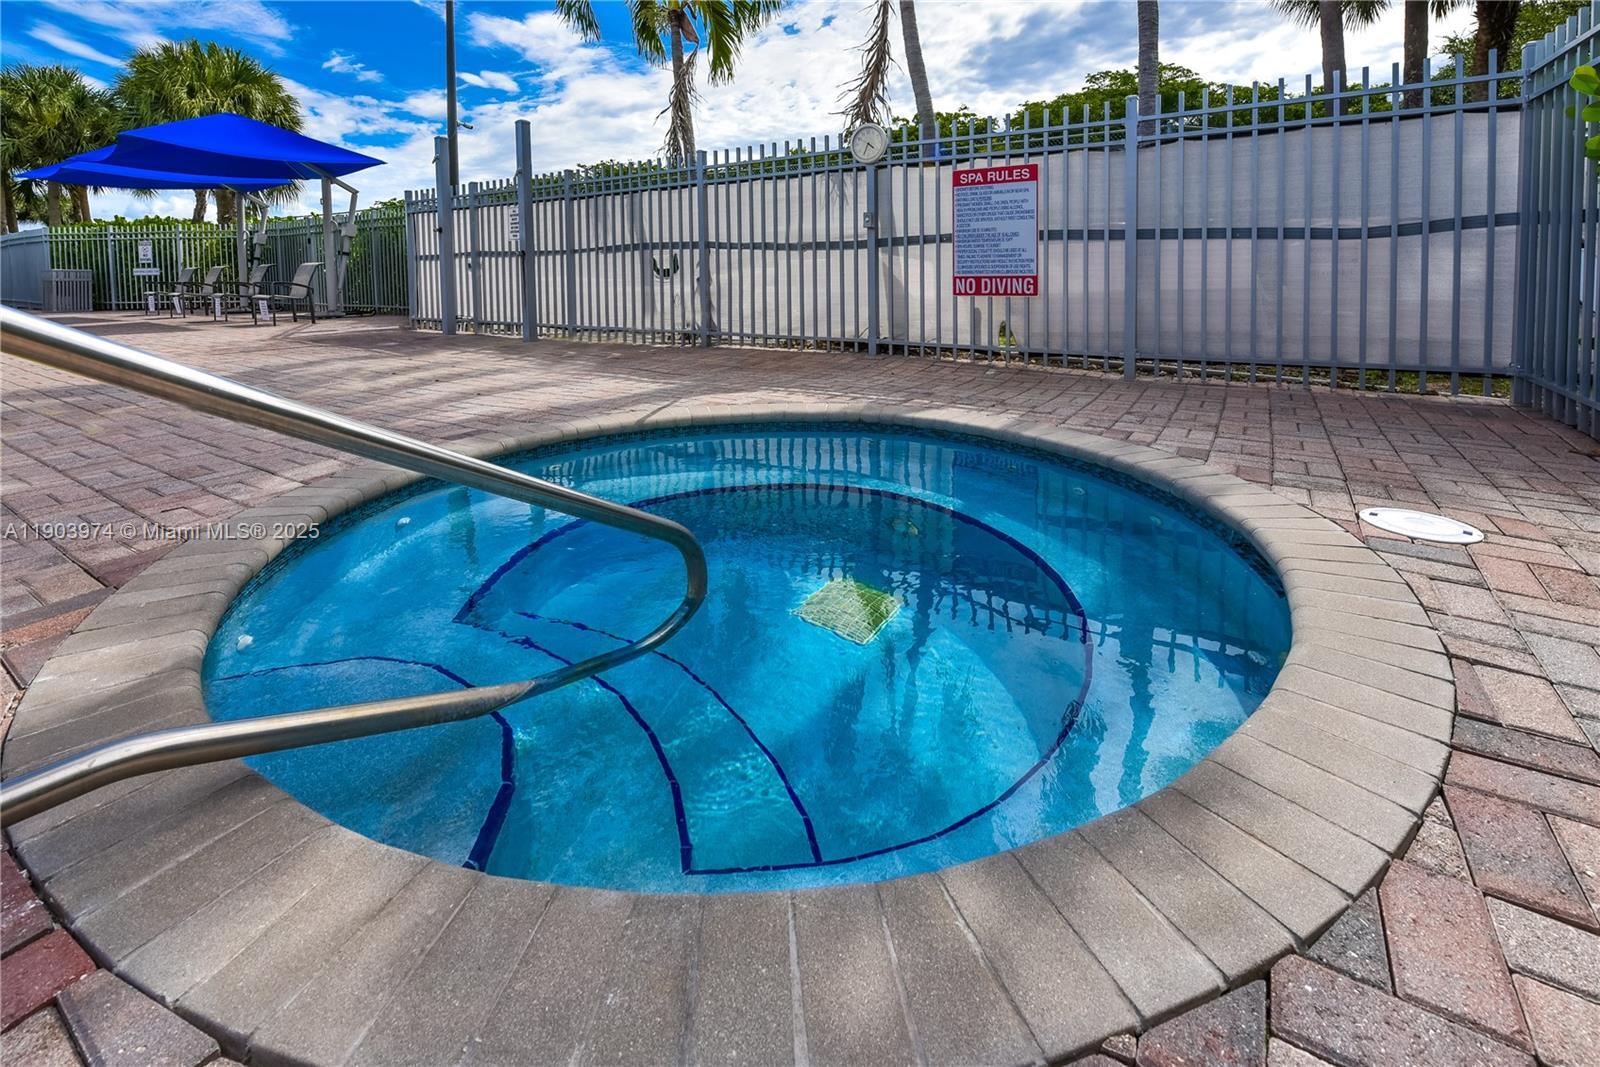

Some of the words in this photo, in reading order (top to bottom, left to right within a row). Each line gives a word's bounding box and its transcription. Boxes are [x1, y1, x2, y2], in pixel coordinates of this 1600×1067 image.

[960, 172, 984, 184] SPA
[987, 168, 1030, 182] RULES
[955, 278, 976, 294] NO
[981, 277, 1034, 294] DIVING
